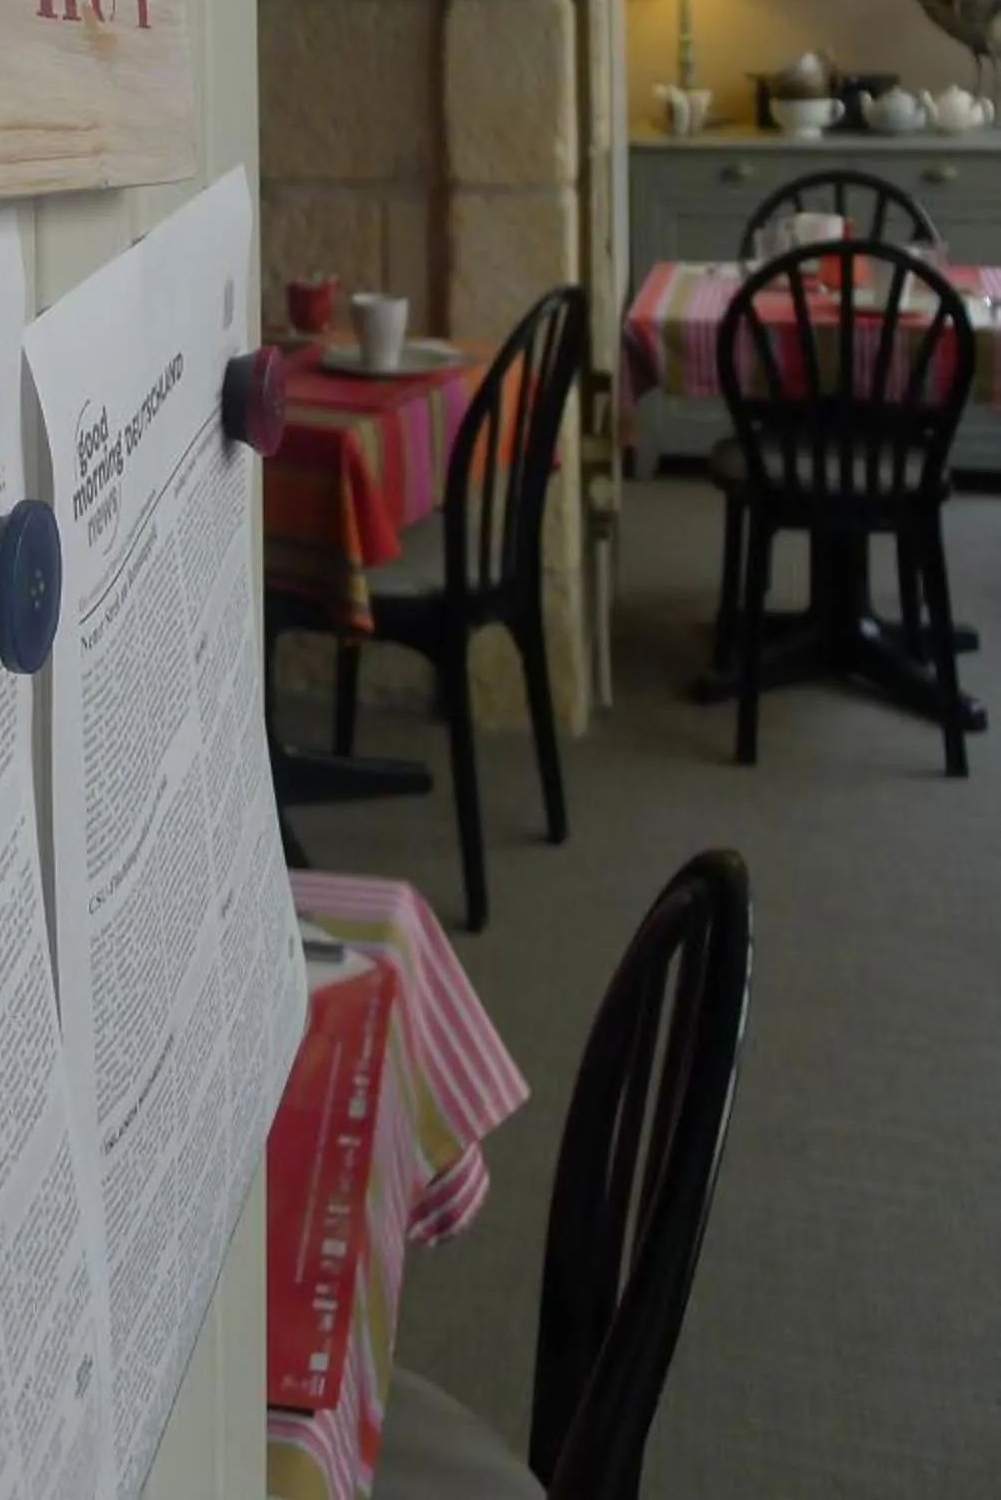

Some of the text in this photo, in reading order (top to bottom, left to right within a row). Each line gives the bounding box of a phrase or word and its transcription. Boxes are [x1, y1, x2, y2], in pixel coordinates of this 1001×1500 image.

[73, 430, 123, 522] morning
[124, 353, 184, 456] DEUTSCHLAND
[78, 404, 109, 479] good
[88, 486, 118, 548] news
